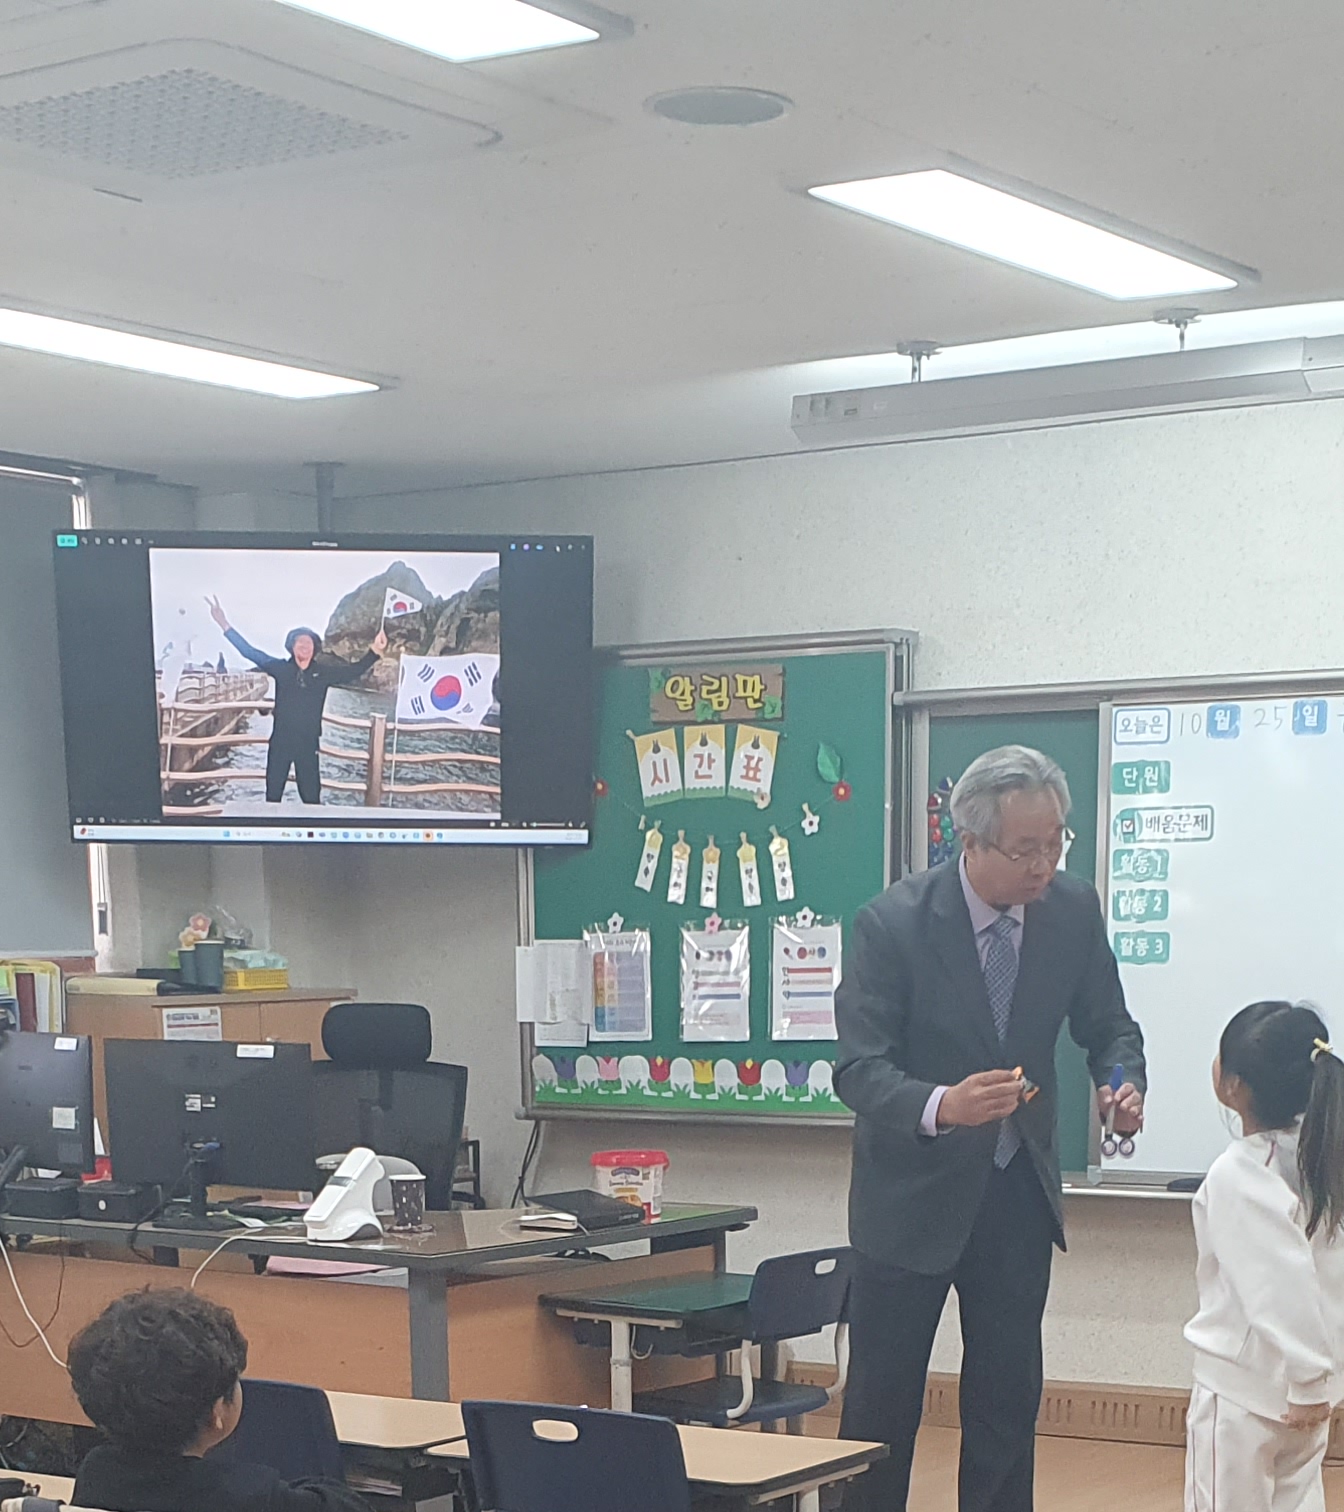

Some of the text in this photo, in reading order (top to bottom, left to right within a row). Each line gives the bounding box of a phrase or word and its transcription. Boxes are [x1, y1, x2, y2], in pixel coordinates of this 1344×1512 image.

[665, 673, 765, 711] 알림판
[1119, 715, 1164, 735] 오늘은
[1180, 712, 1202, 736] 10
[1213, 709, 1231, 730] 월
[1254, 706, 1287, 731] 25
[1302, 705, 1319, 727] 일
[651, 754, 763, 787] 시간표
[1145, 813, 1209, 833] 배움문제
[1153, 896, 1162, 912] 2
[1154, 938, 1163, 954] 3
